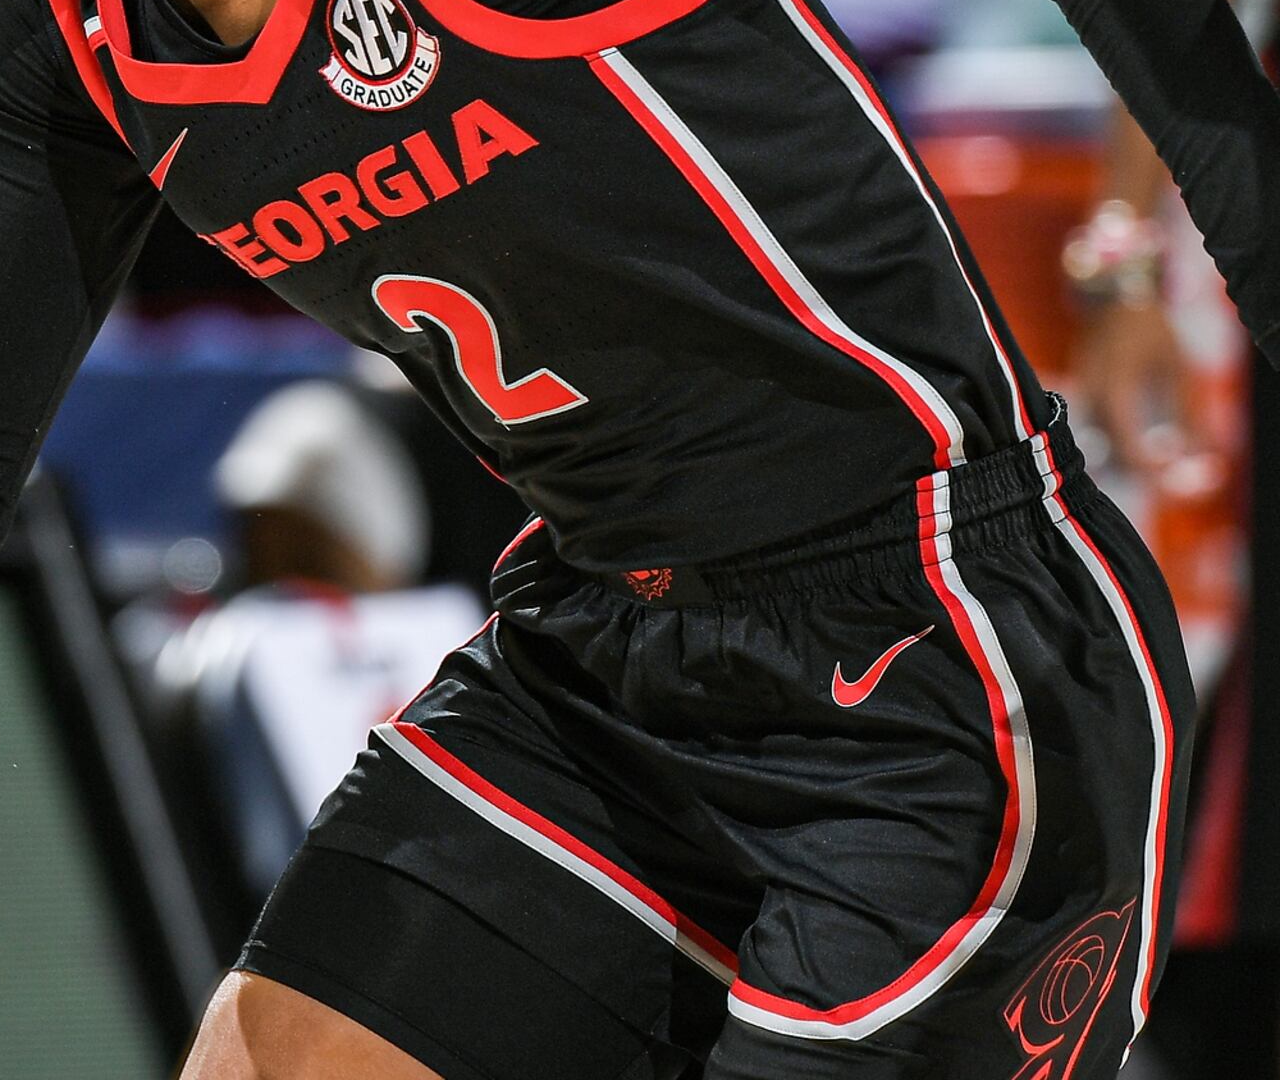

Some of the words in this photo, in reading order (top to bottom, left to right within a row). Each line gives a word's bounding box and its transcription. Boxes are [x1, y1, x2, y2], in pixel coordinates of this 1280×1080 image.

[340, 56, 433, 108] GRADUATE
[196, 99, 540, 279] EORGIA
[370, 274, 589, 426] 2
